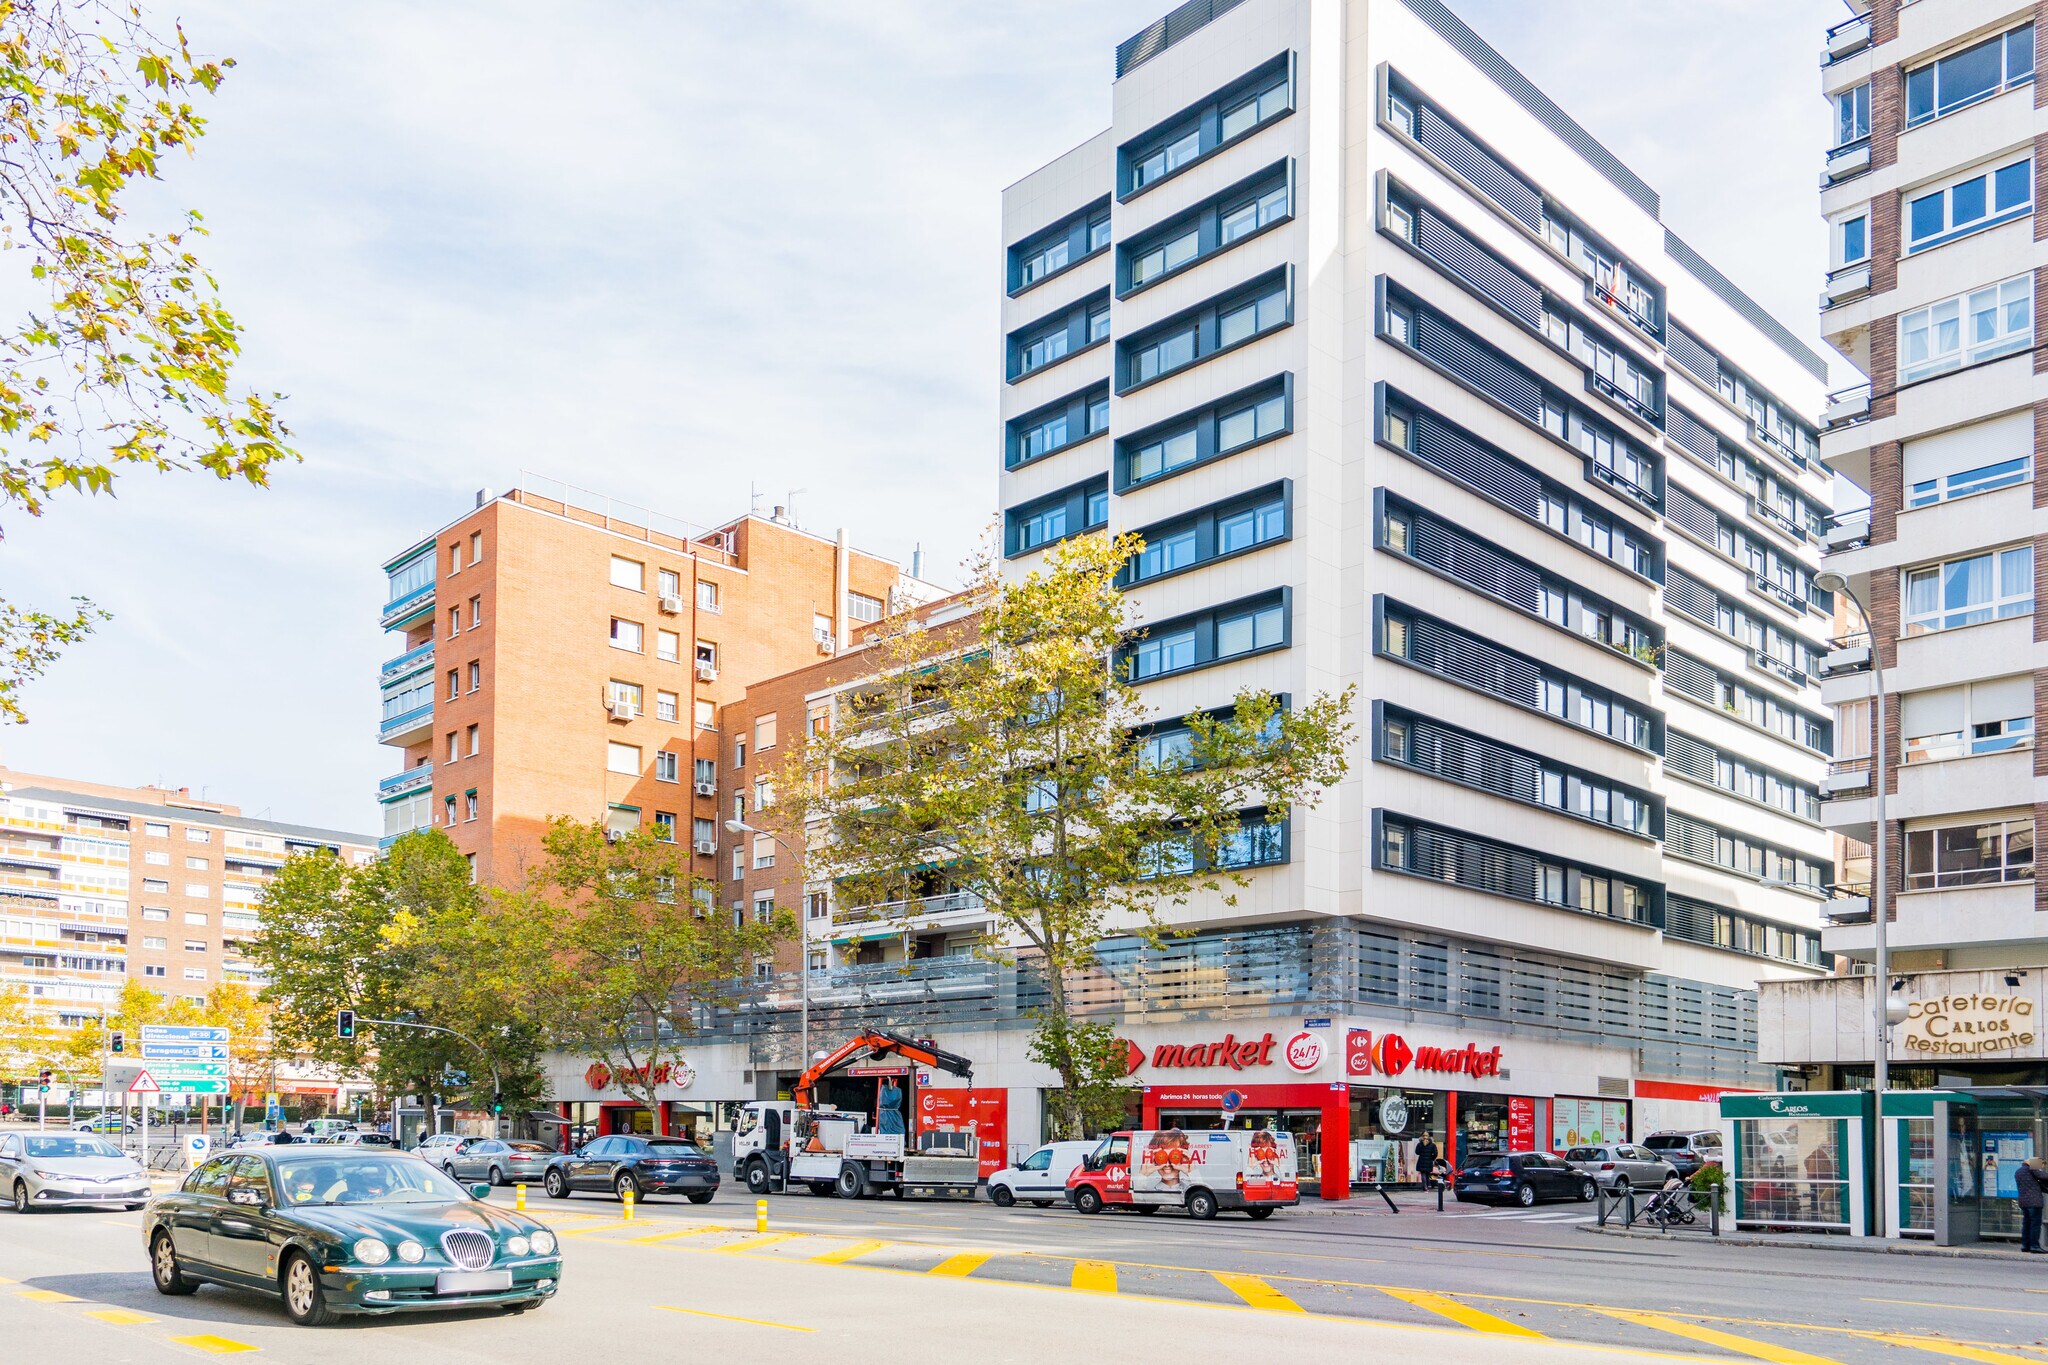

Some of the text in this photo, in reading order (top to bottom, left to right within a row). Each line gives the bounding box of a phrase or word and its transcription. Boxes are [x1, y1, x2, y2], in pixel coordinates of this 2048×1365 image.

[1908, 994, 2032, 1018] Cafetería
[1151, 1032, 1277, 1071] market
[1293, 1045, 1317, 1059] 24/7
[1904, 1032, 2034, 1053] Restaurante
[1415, 1043, 1503, 1078] market
[981, 1159, 1000, 1167] market
